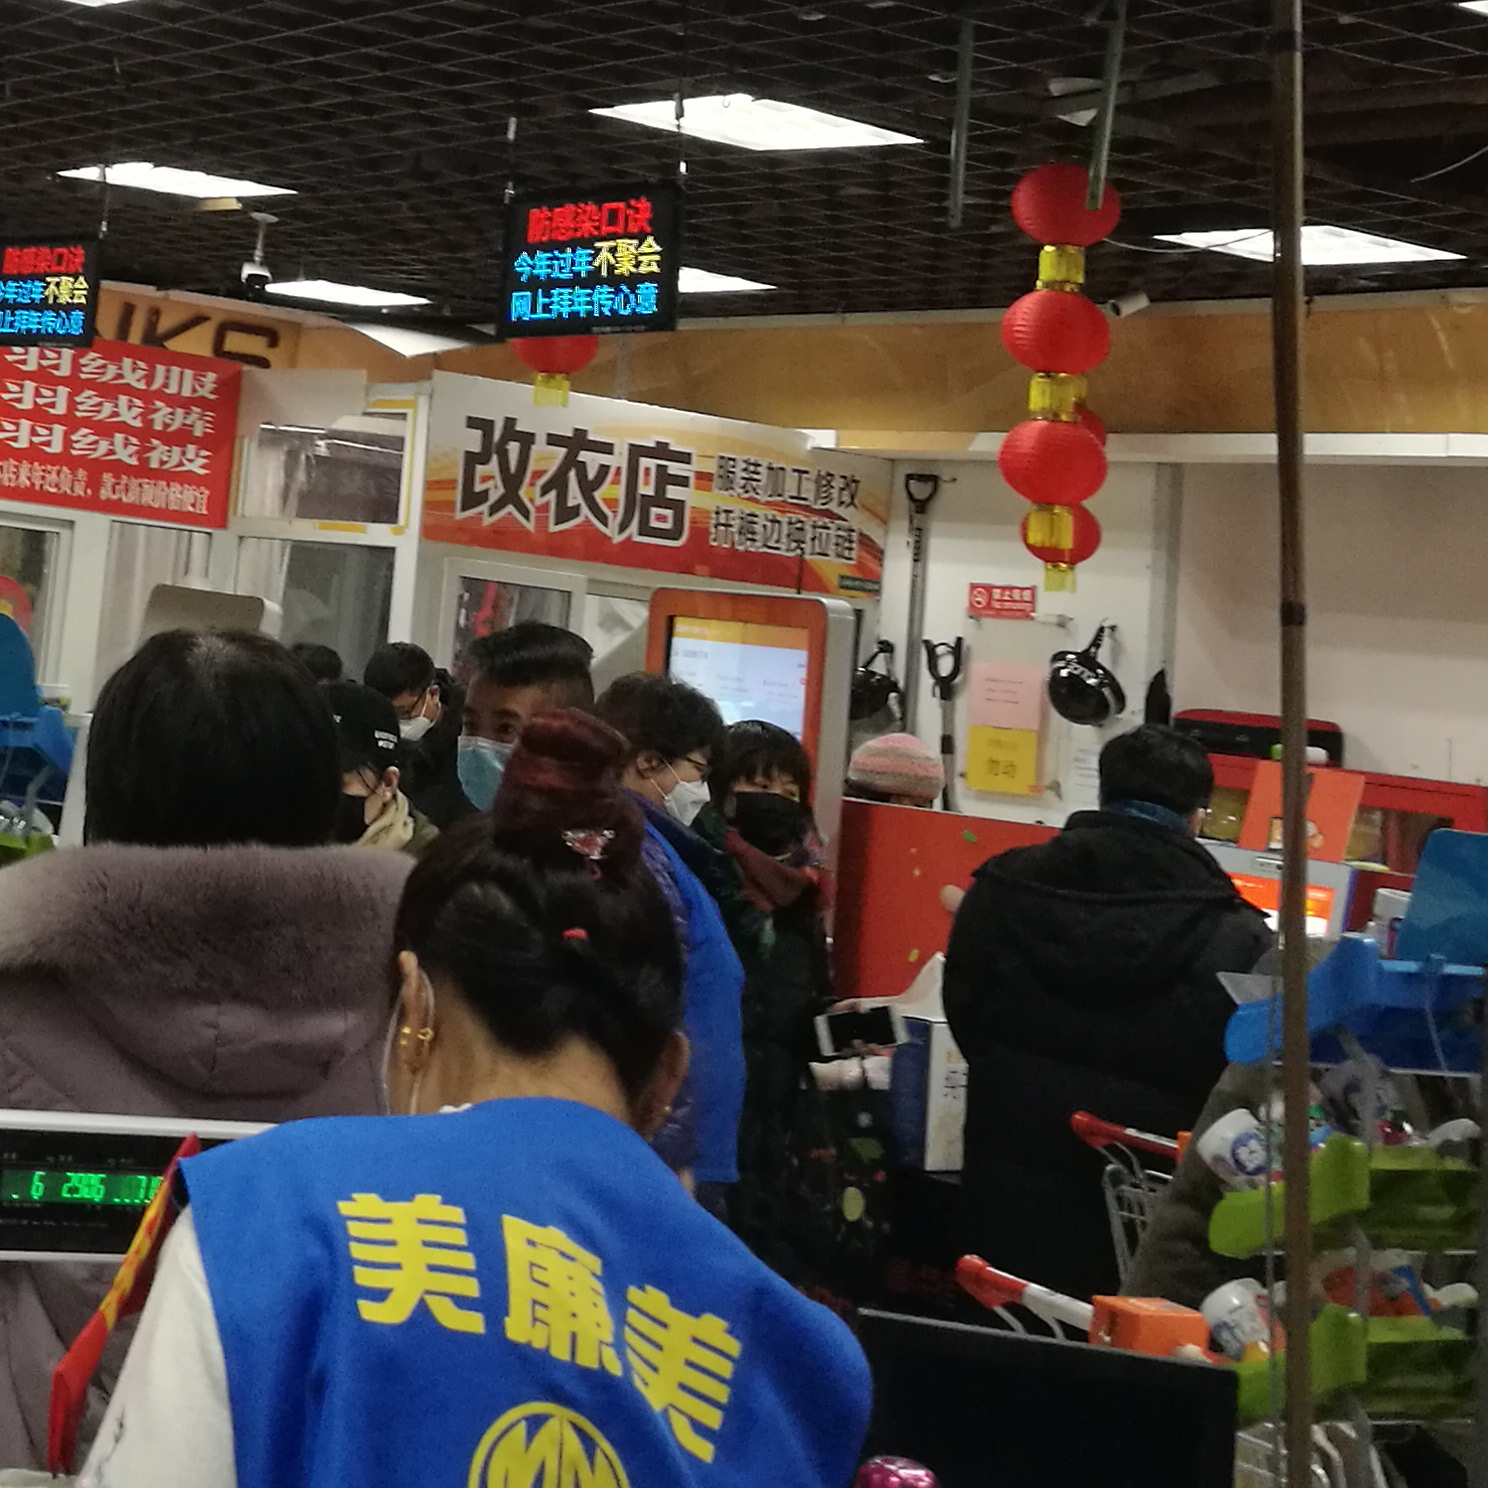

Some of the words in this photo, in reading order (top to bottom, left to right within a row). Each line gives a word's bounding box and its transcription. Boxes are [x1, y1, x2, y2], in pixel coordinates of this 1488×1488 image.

[514, 235, 662, 283] 今年过年不聚会
[5, 346, 218, 399] 羽绒服
[0, 379, 215, 437] 羽绒裤
[460, 416, 693, 543] 改衣店
[717, 454, 861, 510] 服装加工修改
[337, 1192, 744, 1463] 美廉美
